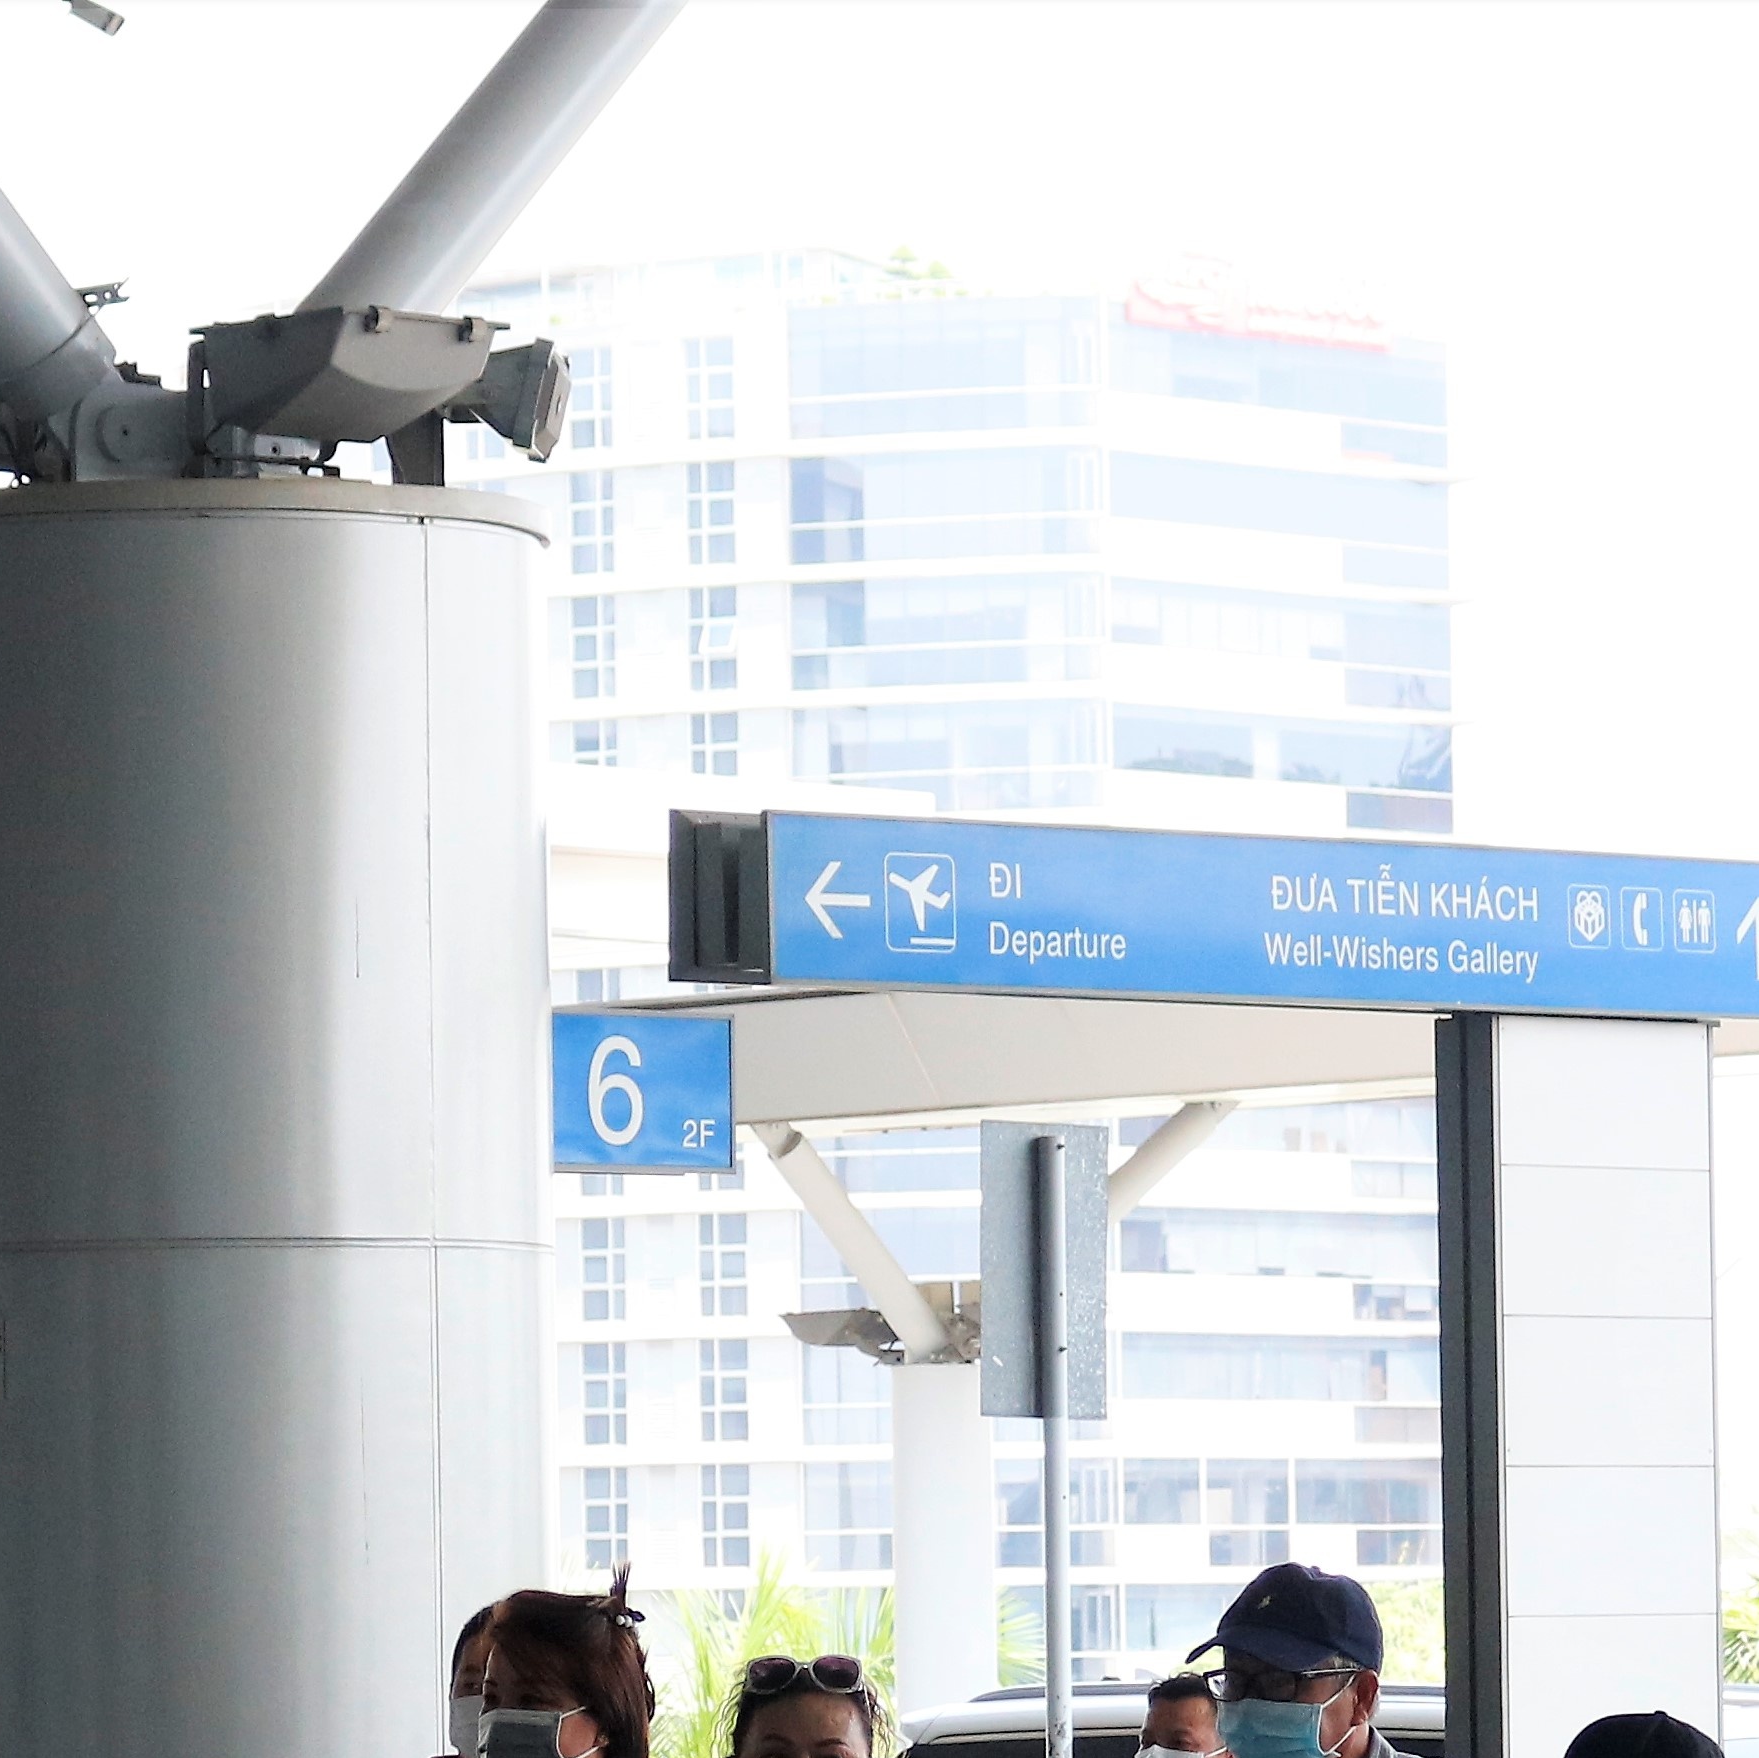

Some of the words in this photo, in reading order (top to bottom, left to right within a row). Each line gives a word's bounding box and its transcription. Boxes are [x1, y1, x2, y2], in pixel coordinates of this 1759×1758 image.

[989, 862, 1022, 899] ĐI
[1271, 872, 1338, 913] ĐƯA
[1346, 863, 1420, 916] TIỄN
[1430, 875, 1539, 922] KHÁCH
[989, 921, 1127, 964] Departure
[1264, 932, 1440, 971] Well-Wishers
[1447, 939, 1539, 983] Gallery
[588, 1034, 644, 1147] 6
[682, 1119, 716, 1148] 2F
